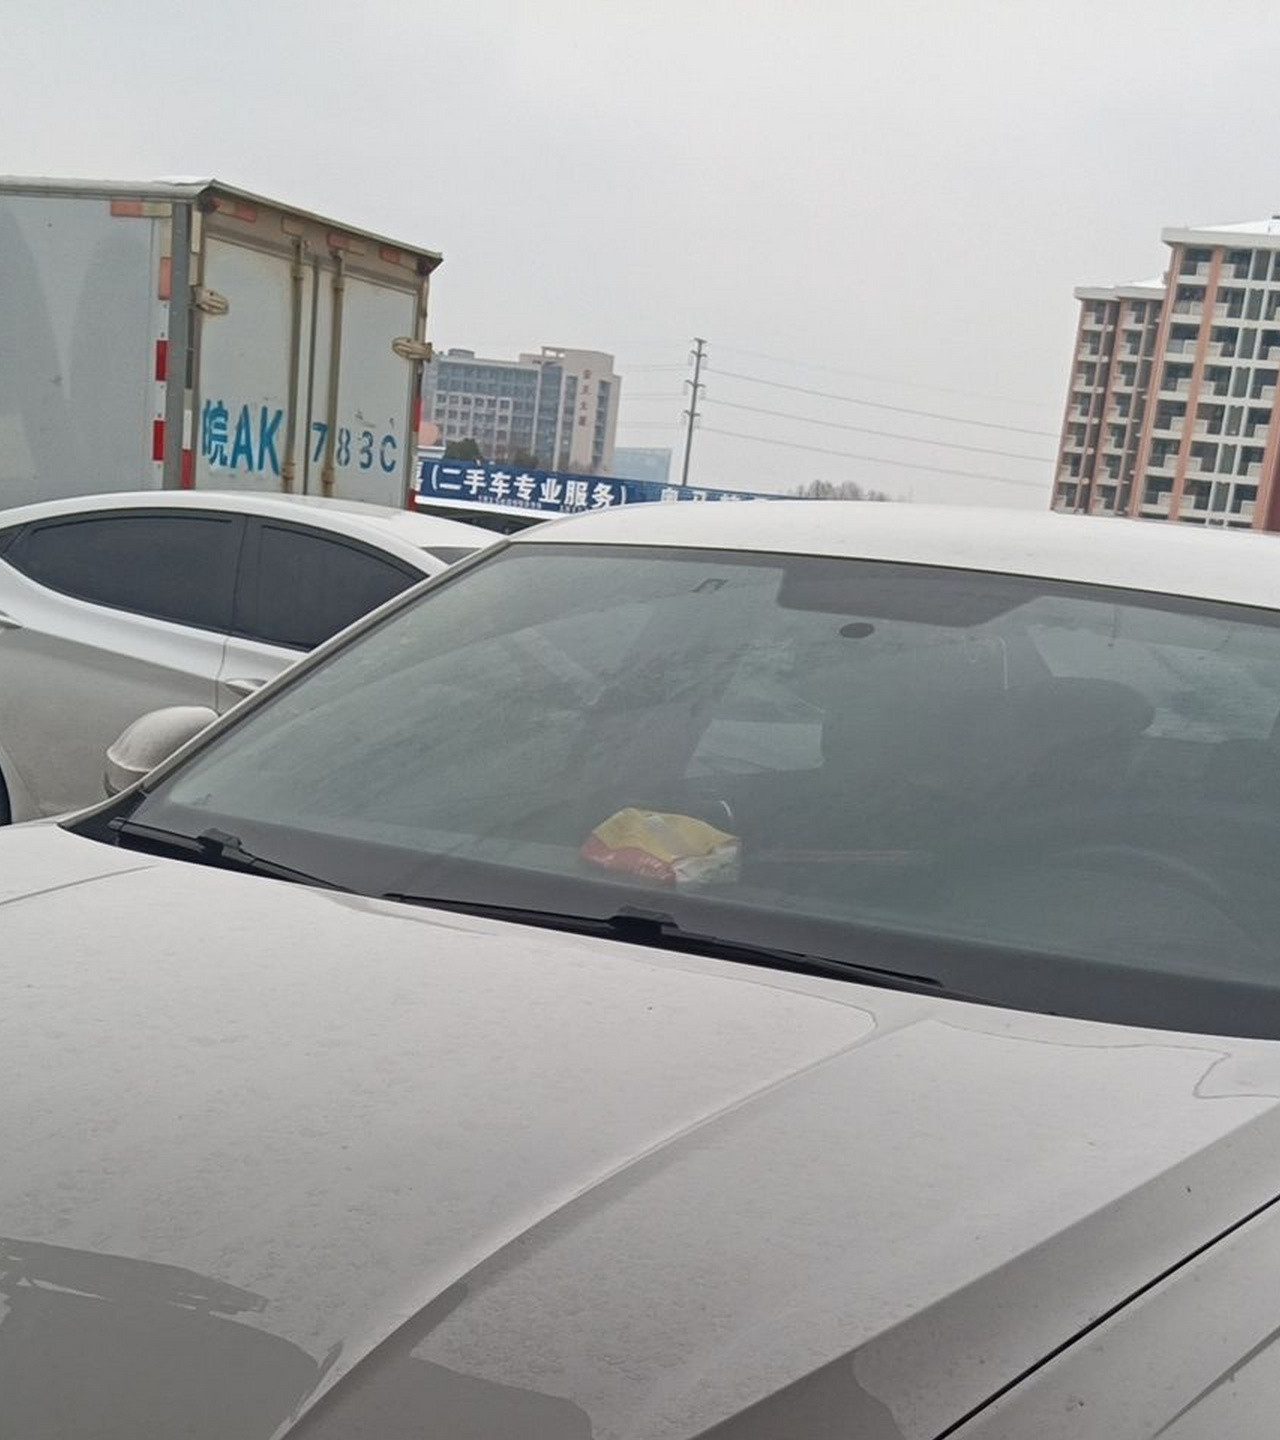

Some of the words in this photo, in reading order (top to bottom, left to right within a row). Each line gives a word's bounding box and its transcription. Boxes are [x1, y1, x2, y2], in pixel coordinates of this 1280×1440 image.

[415, 461, 627, 508] （二手车专业服务）
